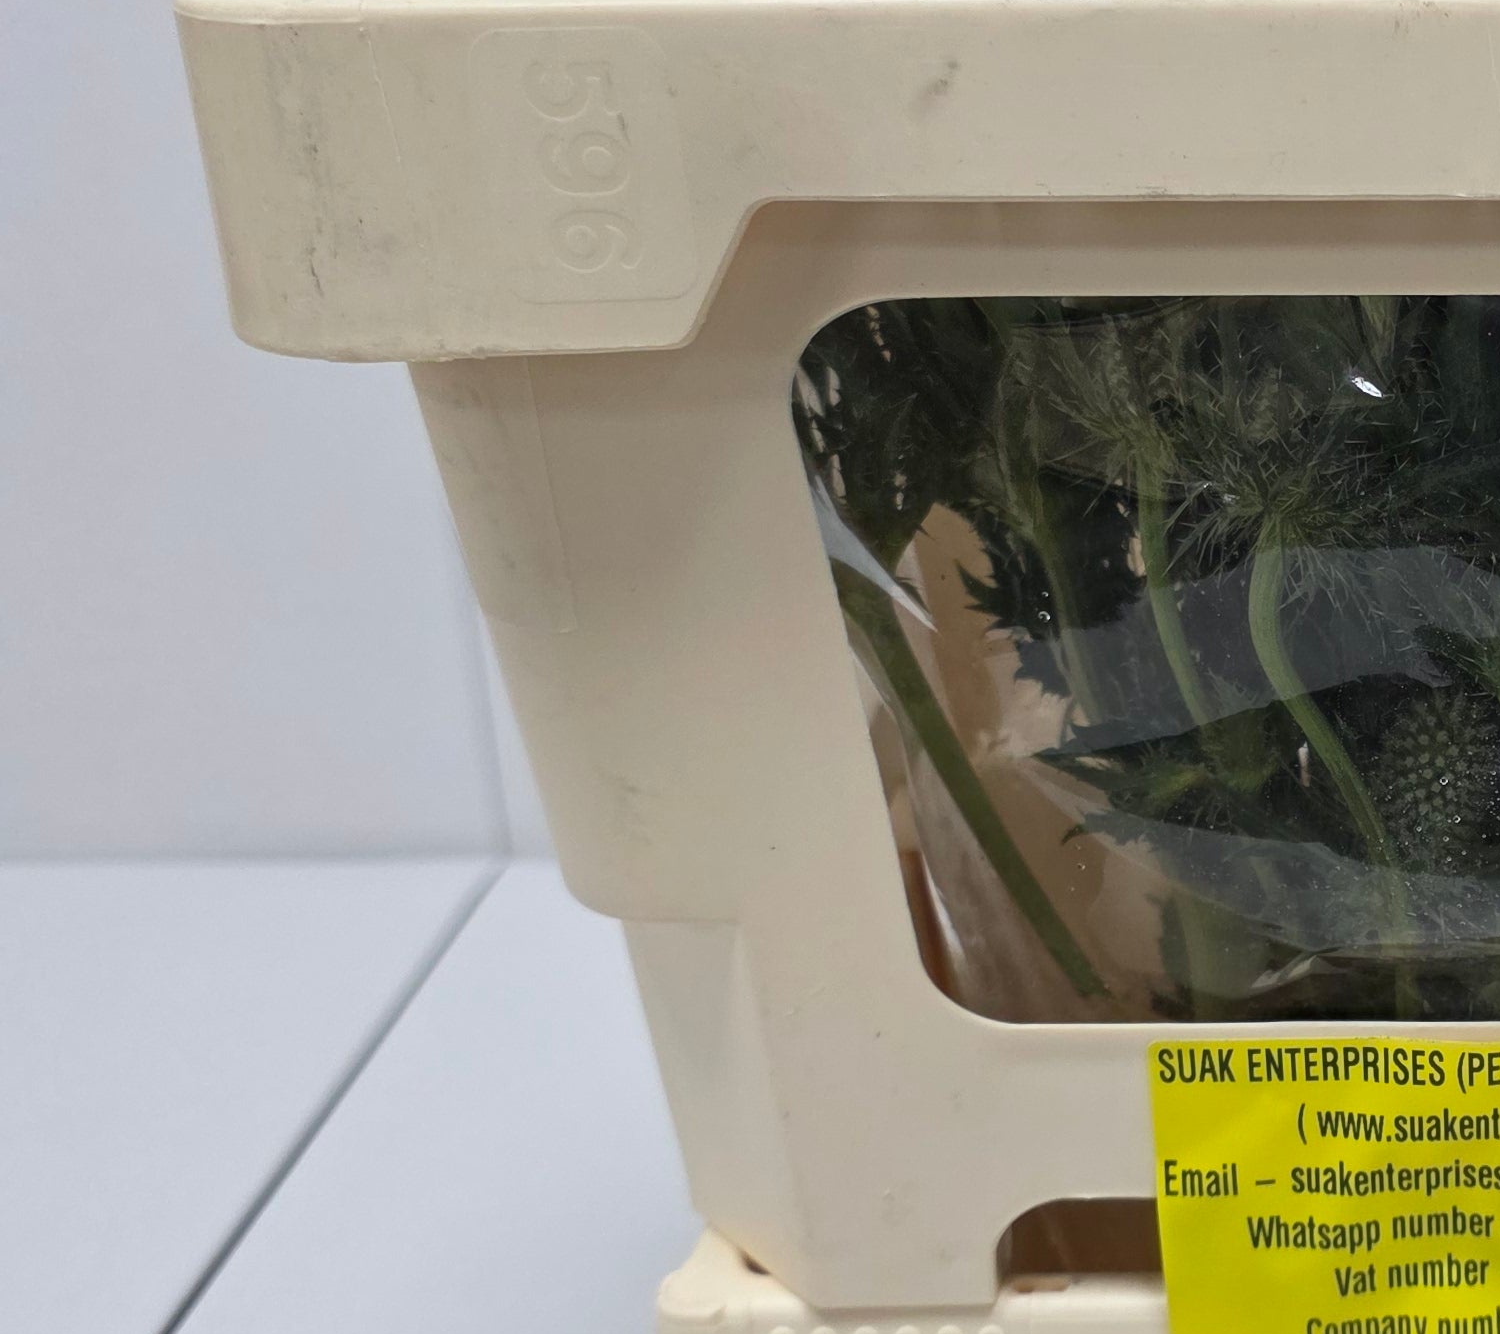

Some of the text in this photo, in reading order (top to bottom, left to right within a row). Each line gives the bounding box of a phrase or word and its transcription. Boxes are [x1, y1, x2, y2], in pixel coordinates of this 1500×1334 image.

[523, 60, 646, 274] 596
[1157, 1047, 1237, 1084] SUAK
[1246, 1045, 1446, 1087] ENTERPRISES
[1163, 1158, 1239, 1199] Email
[1246, 1214, 1381, 1256] Whatsapp
[1392, 1204, 1495, 1241] number
[1334, 1263, 1377, 1298] Vat
[1387, 1252, 1490, 1290] number
